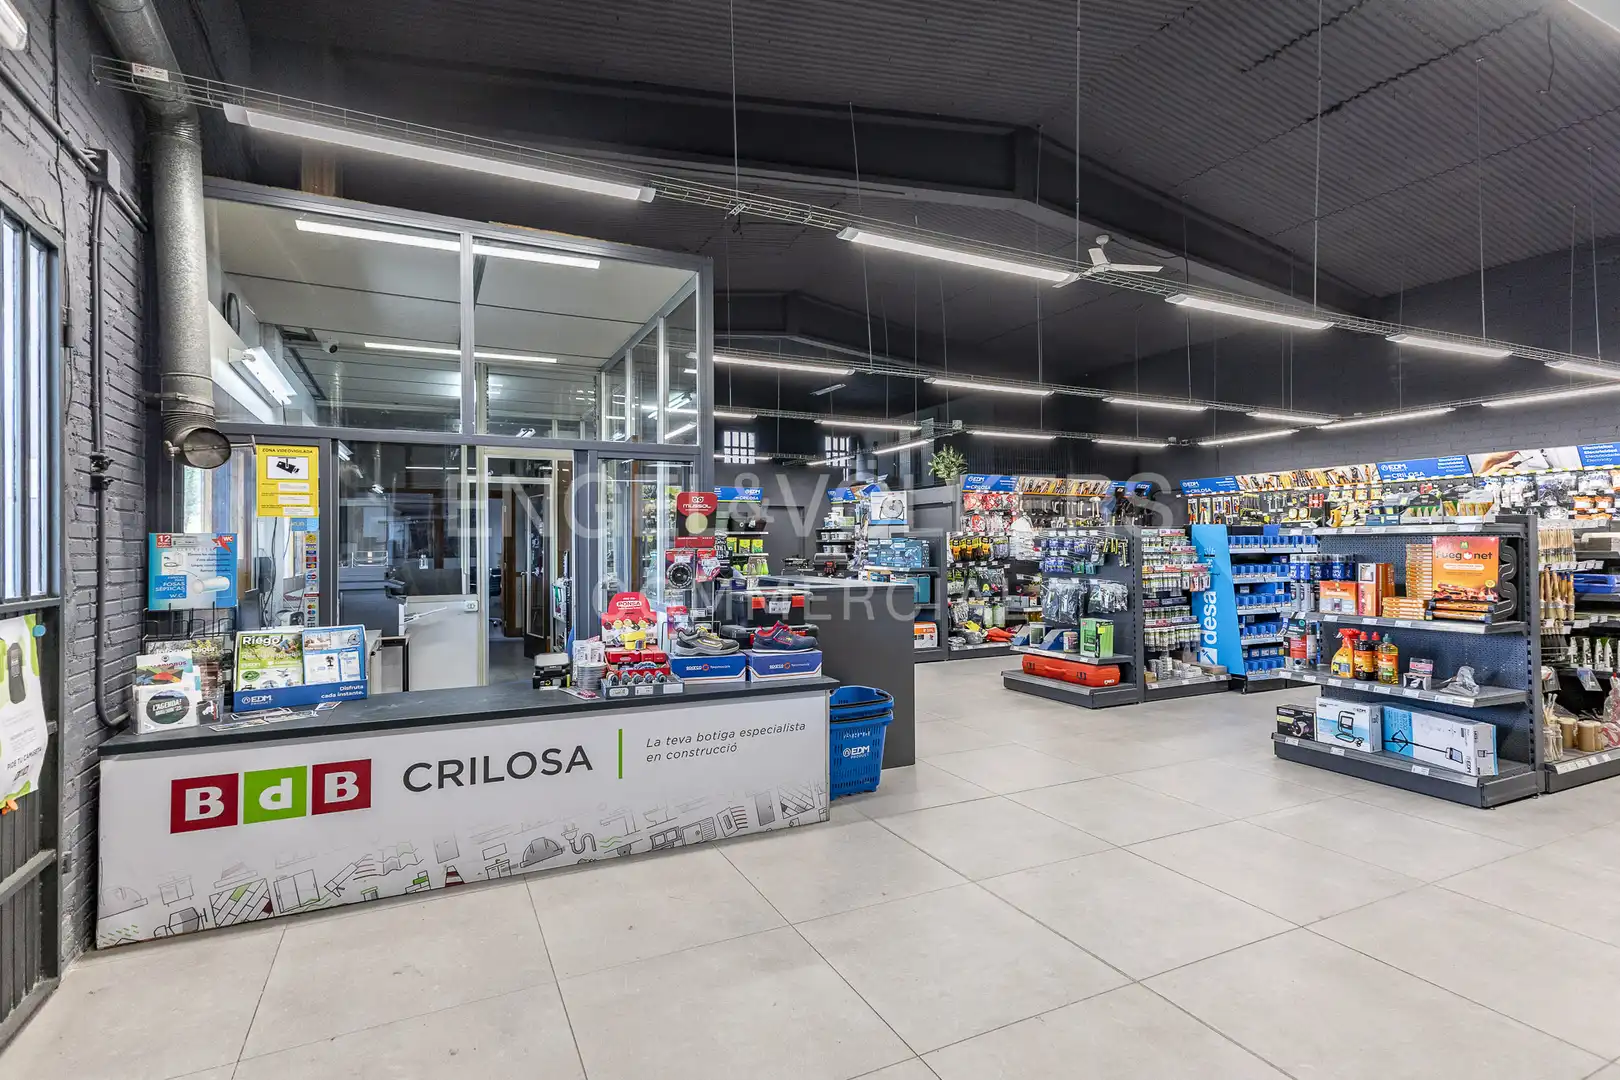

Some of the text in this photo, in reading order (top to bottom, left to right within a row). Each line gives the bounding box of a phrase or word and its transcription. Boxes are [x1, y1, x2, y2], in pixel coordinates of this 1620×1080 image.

[158, 535, 171, 543] 12
[1198, 591, 1217, 645] desa
[242, 635, 280, 646] Riego
[250, 695, 272, 703] EDM
[321, 690, 364, 700] cada instante.
[646, 722, 806, 748] La teva botiga especialista
[646, 742, 737, 763] en construcció
[851, 745, 870, 756] EDM
[402, 745, 594, 793] CRILOSA
[184, 771, 360, 822] BdB
